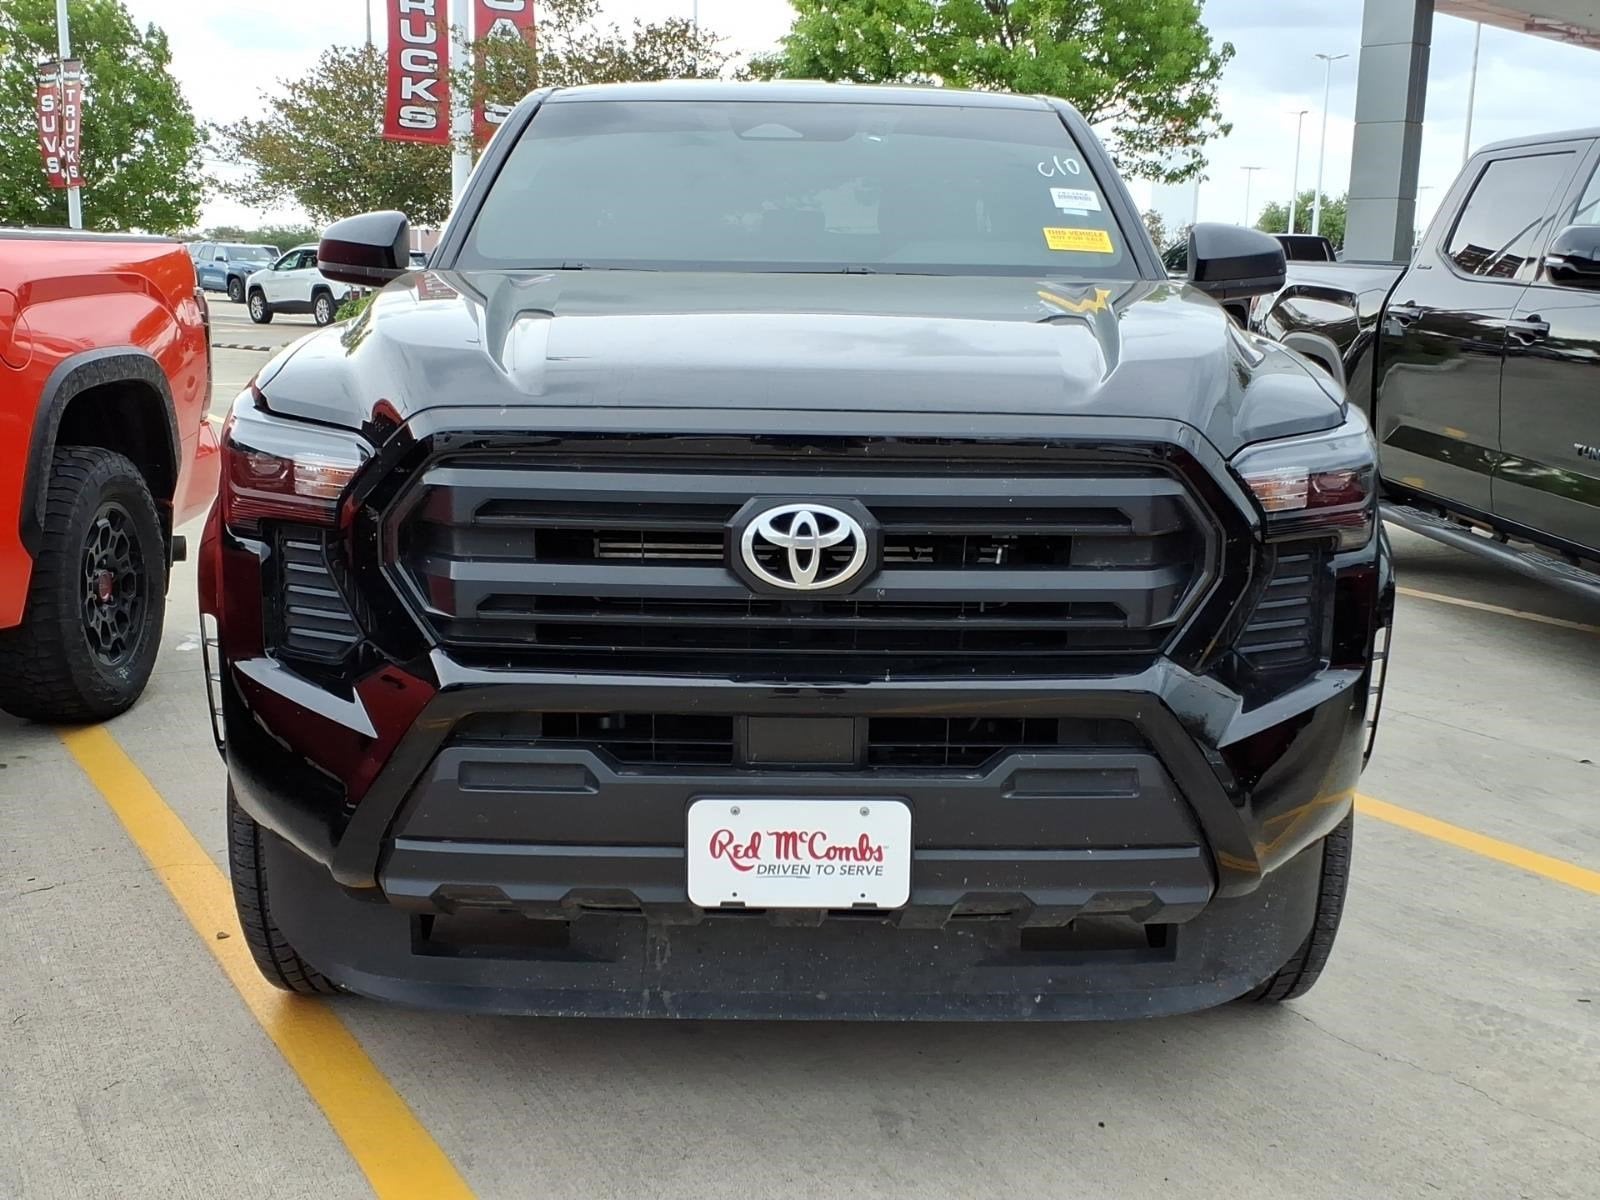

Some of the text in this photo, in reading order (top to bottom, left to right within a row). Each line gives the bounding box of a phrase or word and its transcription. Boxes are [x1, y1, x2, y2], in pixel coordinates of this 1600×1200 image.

[41, 95, 60, 174] SUVS
[65, 89, 79, 178] TRUCKS
[1069, 230, 1104, 238] VEHICLE
[709, 829, 884, 872] Red McCombs
[757, 864, 884, 876] DRIVEN TO SERVE
